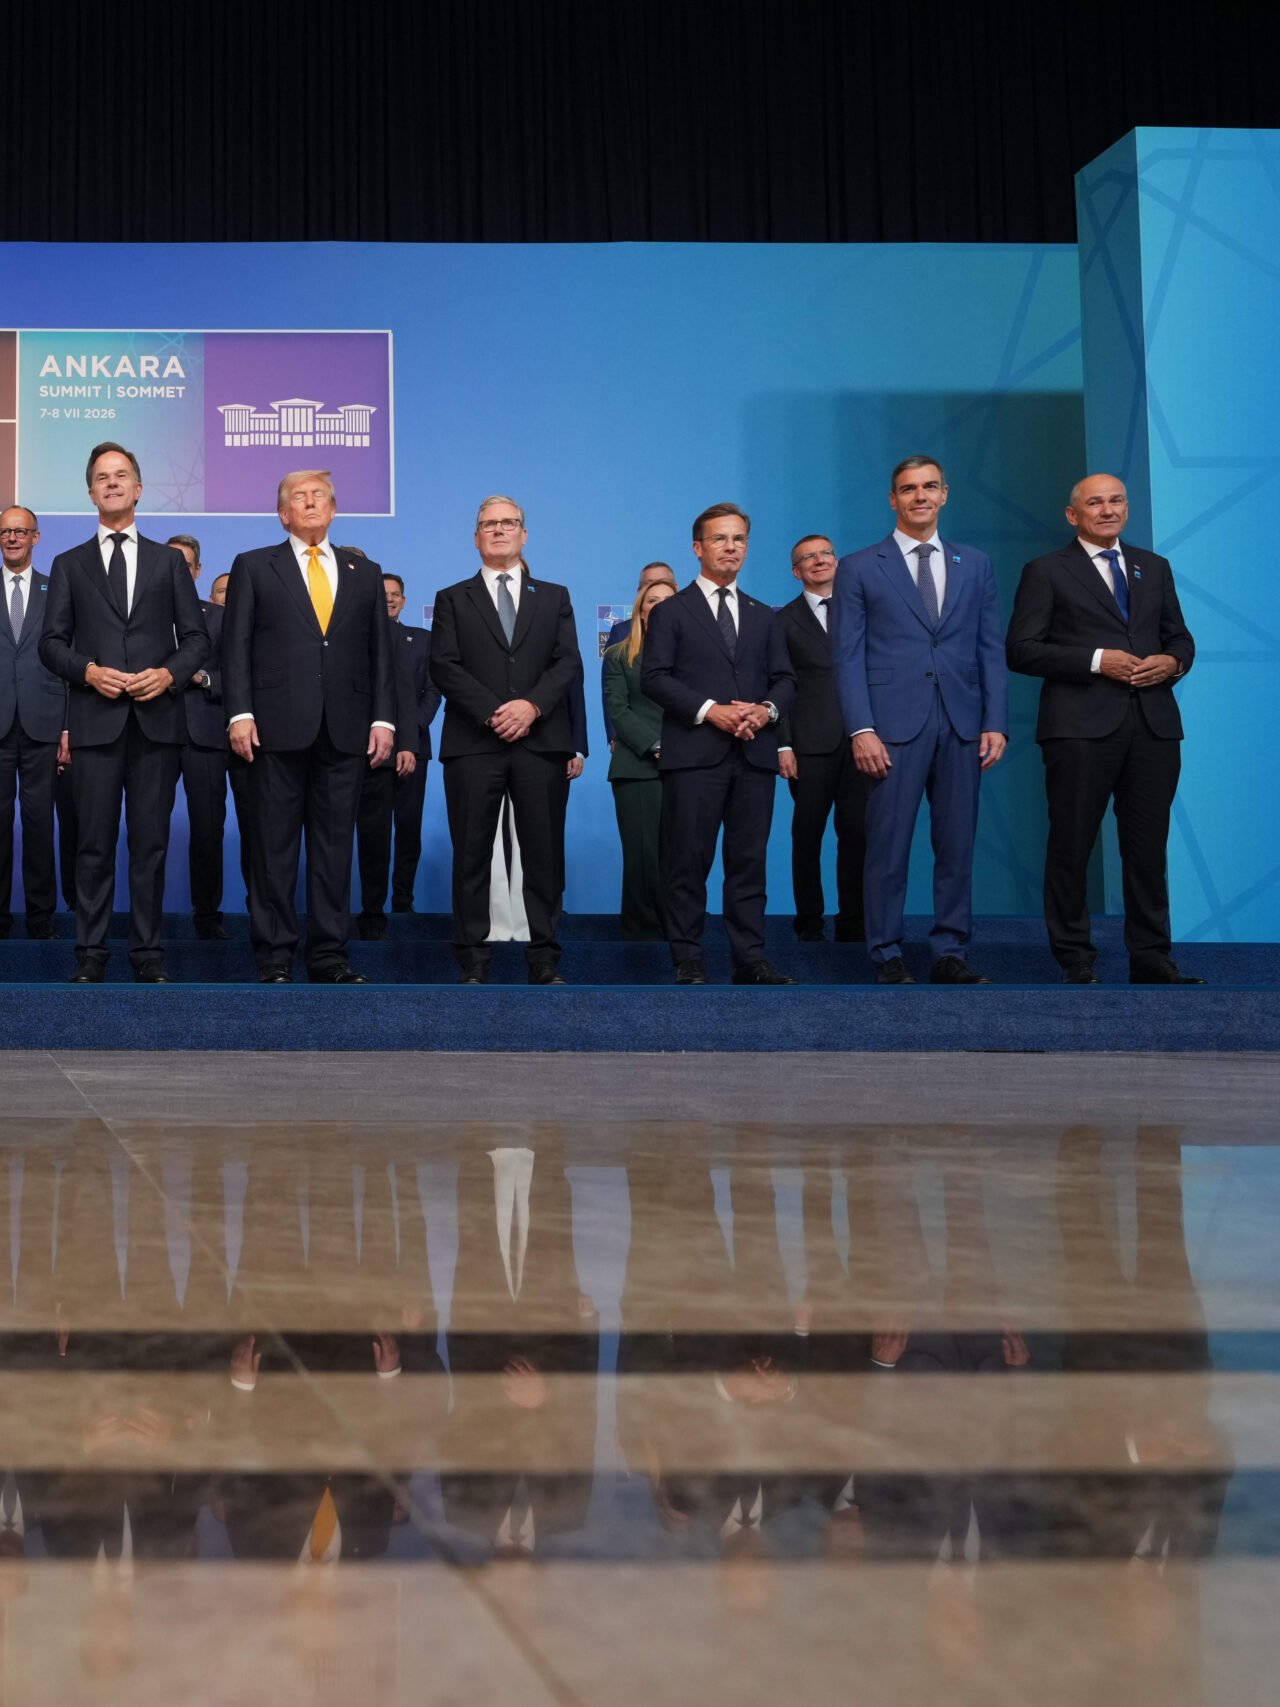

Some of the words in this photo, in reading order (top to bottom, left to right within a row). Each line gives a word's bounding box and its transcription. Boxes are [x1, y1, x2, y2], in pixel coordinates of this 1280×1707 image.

[39, 354, 186, 378] ANKARA
[39, 385, 102, 398] SUMMIT
[116, 385, 186, 398] SOMMET
[39, 408, 60, 419] 7-8
[63, 408, 80, 419] VII
[84, 408, 116, 419] 2026
